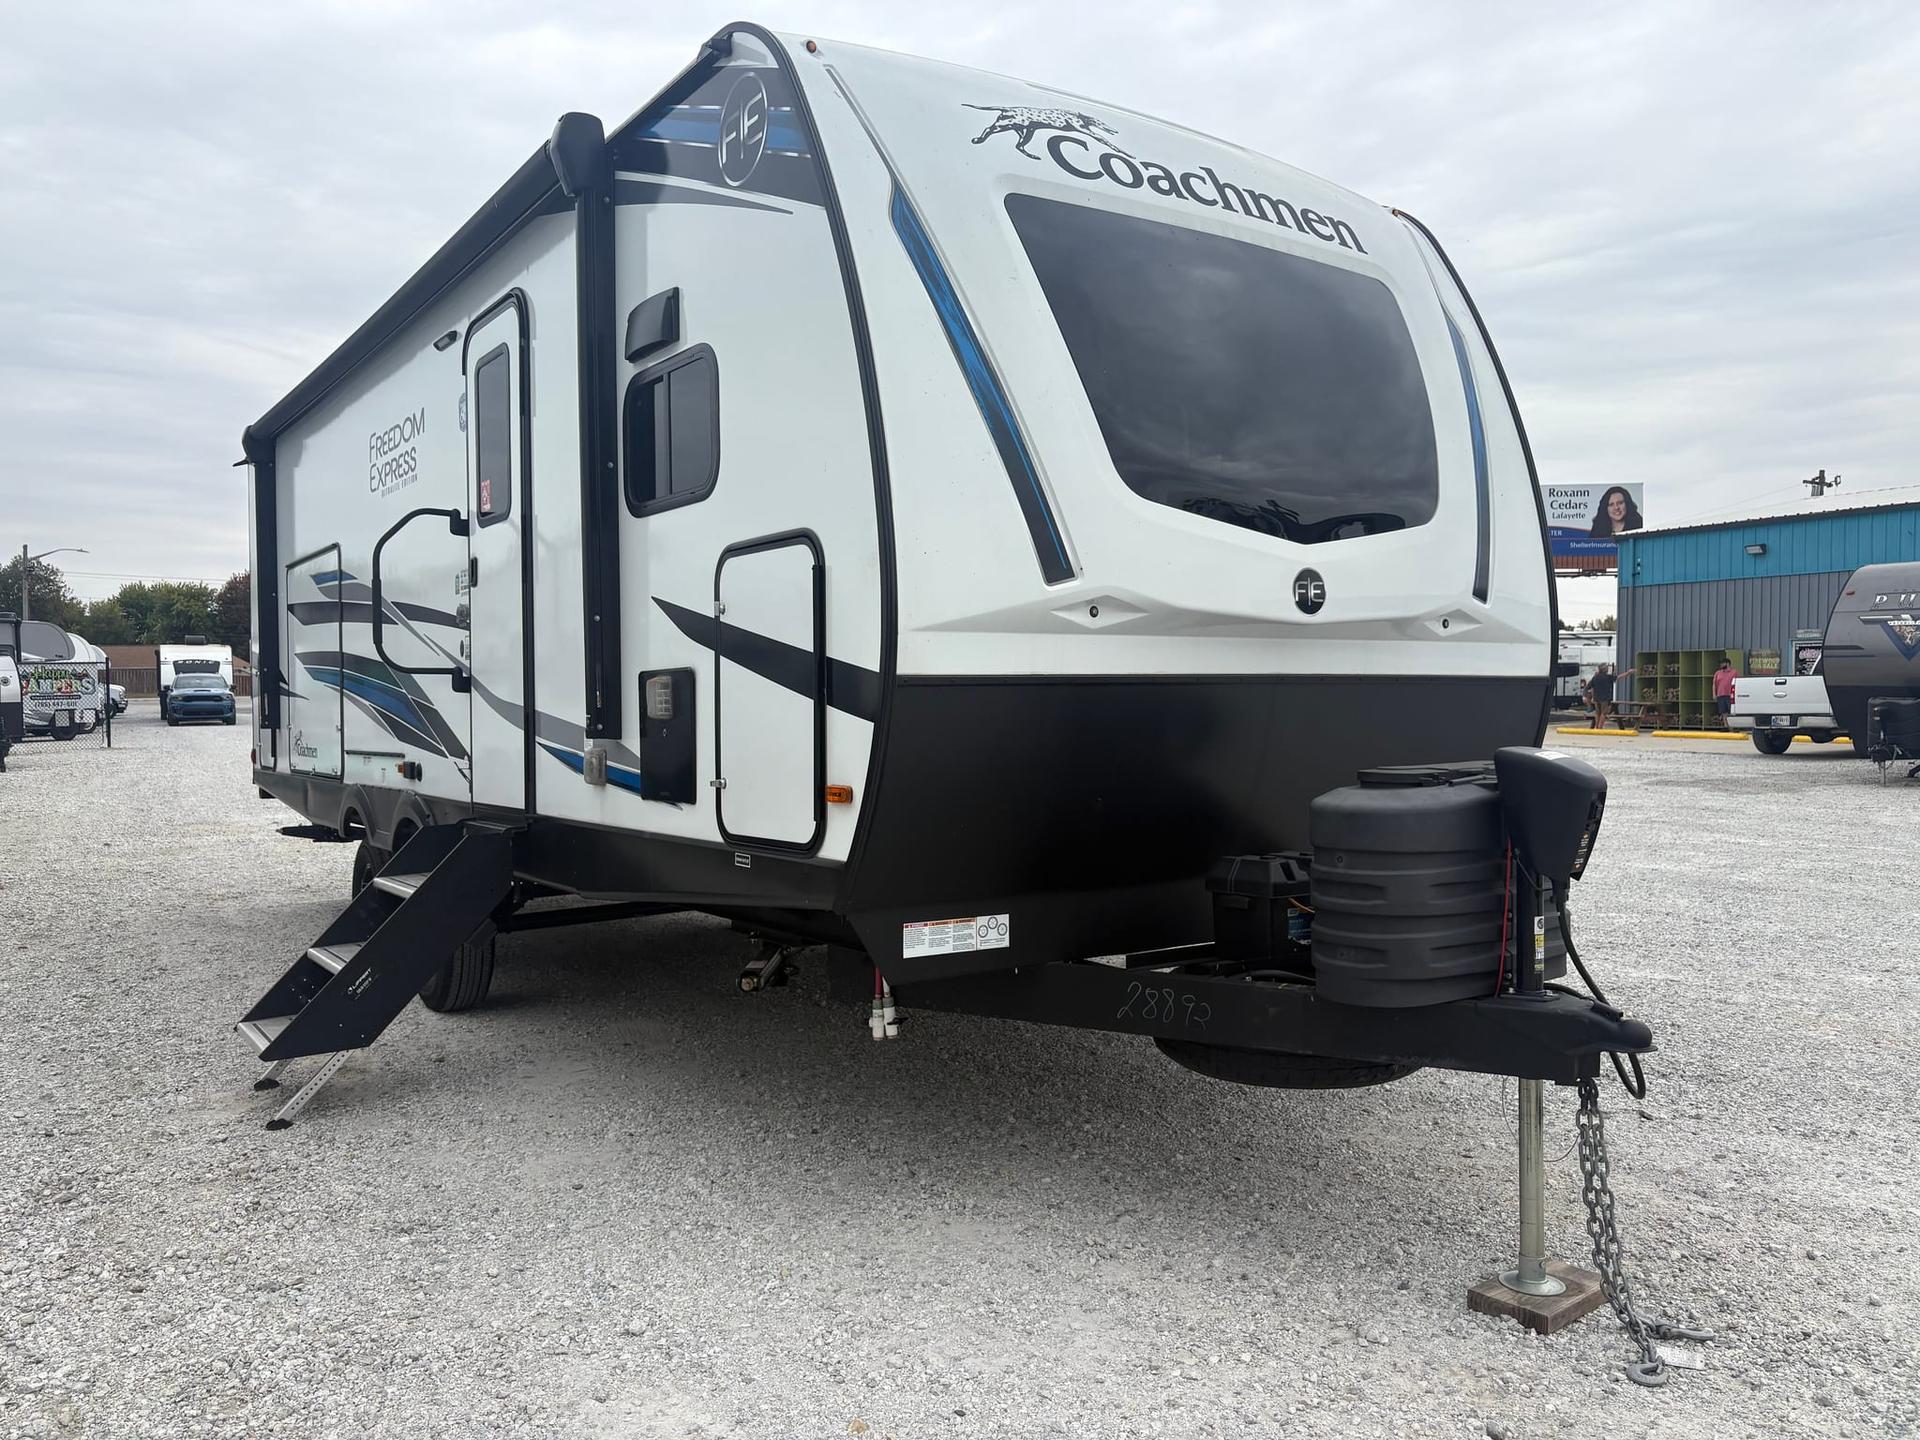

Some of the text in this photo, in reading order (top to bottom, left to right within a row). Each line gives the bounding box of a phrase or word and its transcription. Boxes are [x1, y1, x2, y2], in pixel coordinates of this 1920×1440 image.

[1046, 134, 1369, 255] Coachmen
[369, 406, 425, 464] FREEDOM
[369, 446, 417, 493] EXPRESS
[1548, 487, 1590, 498] Roxann
[1550, 499, 1588, 510] Cedars
[1552, 511, 1586, 520] Lafayette
